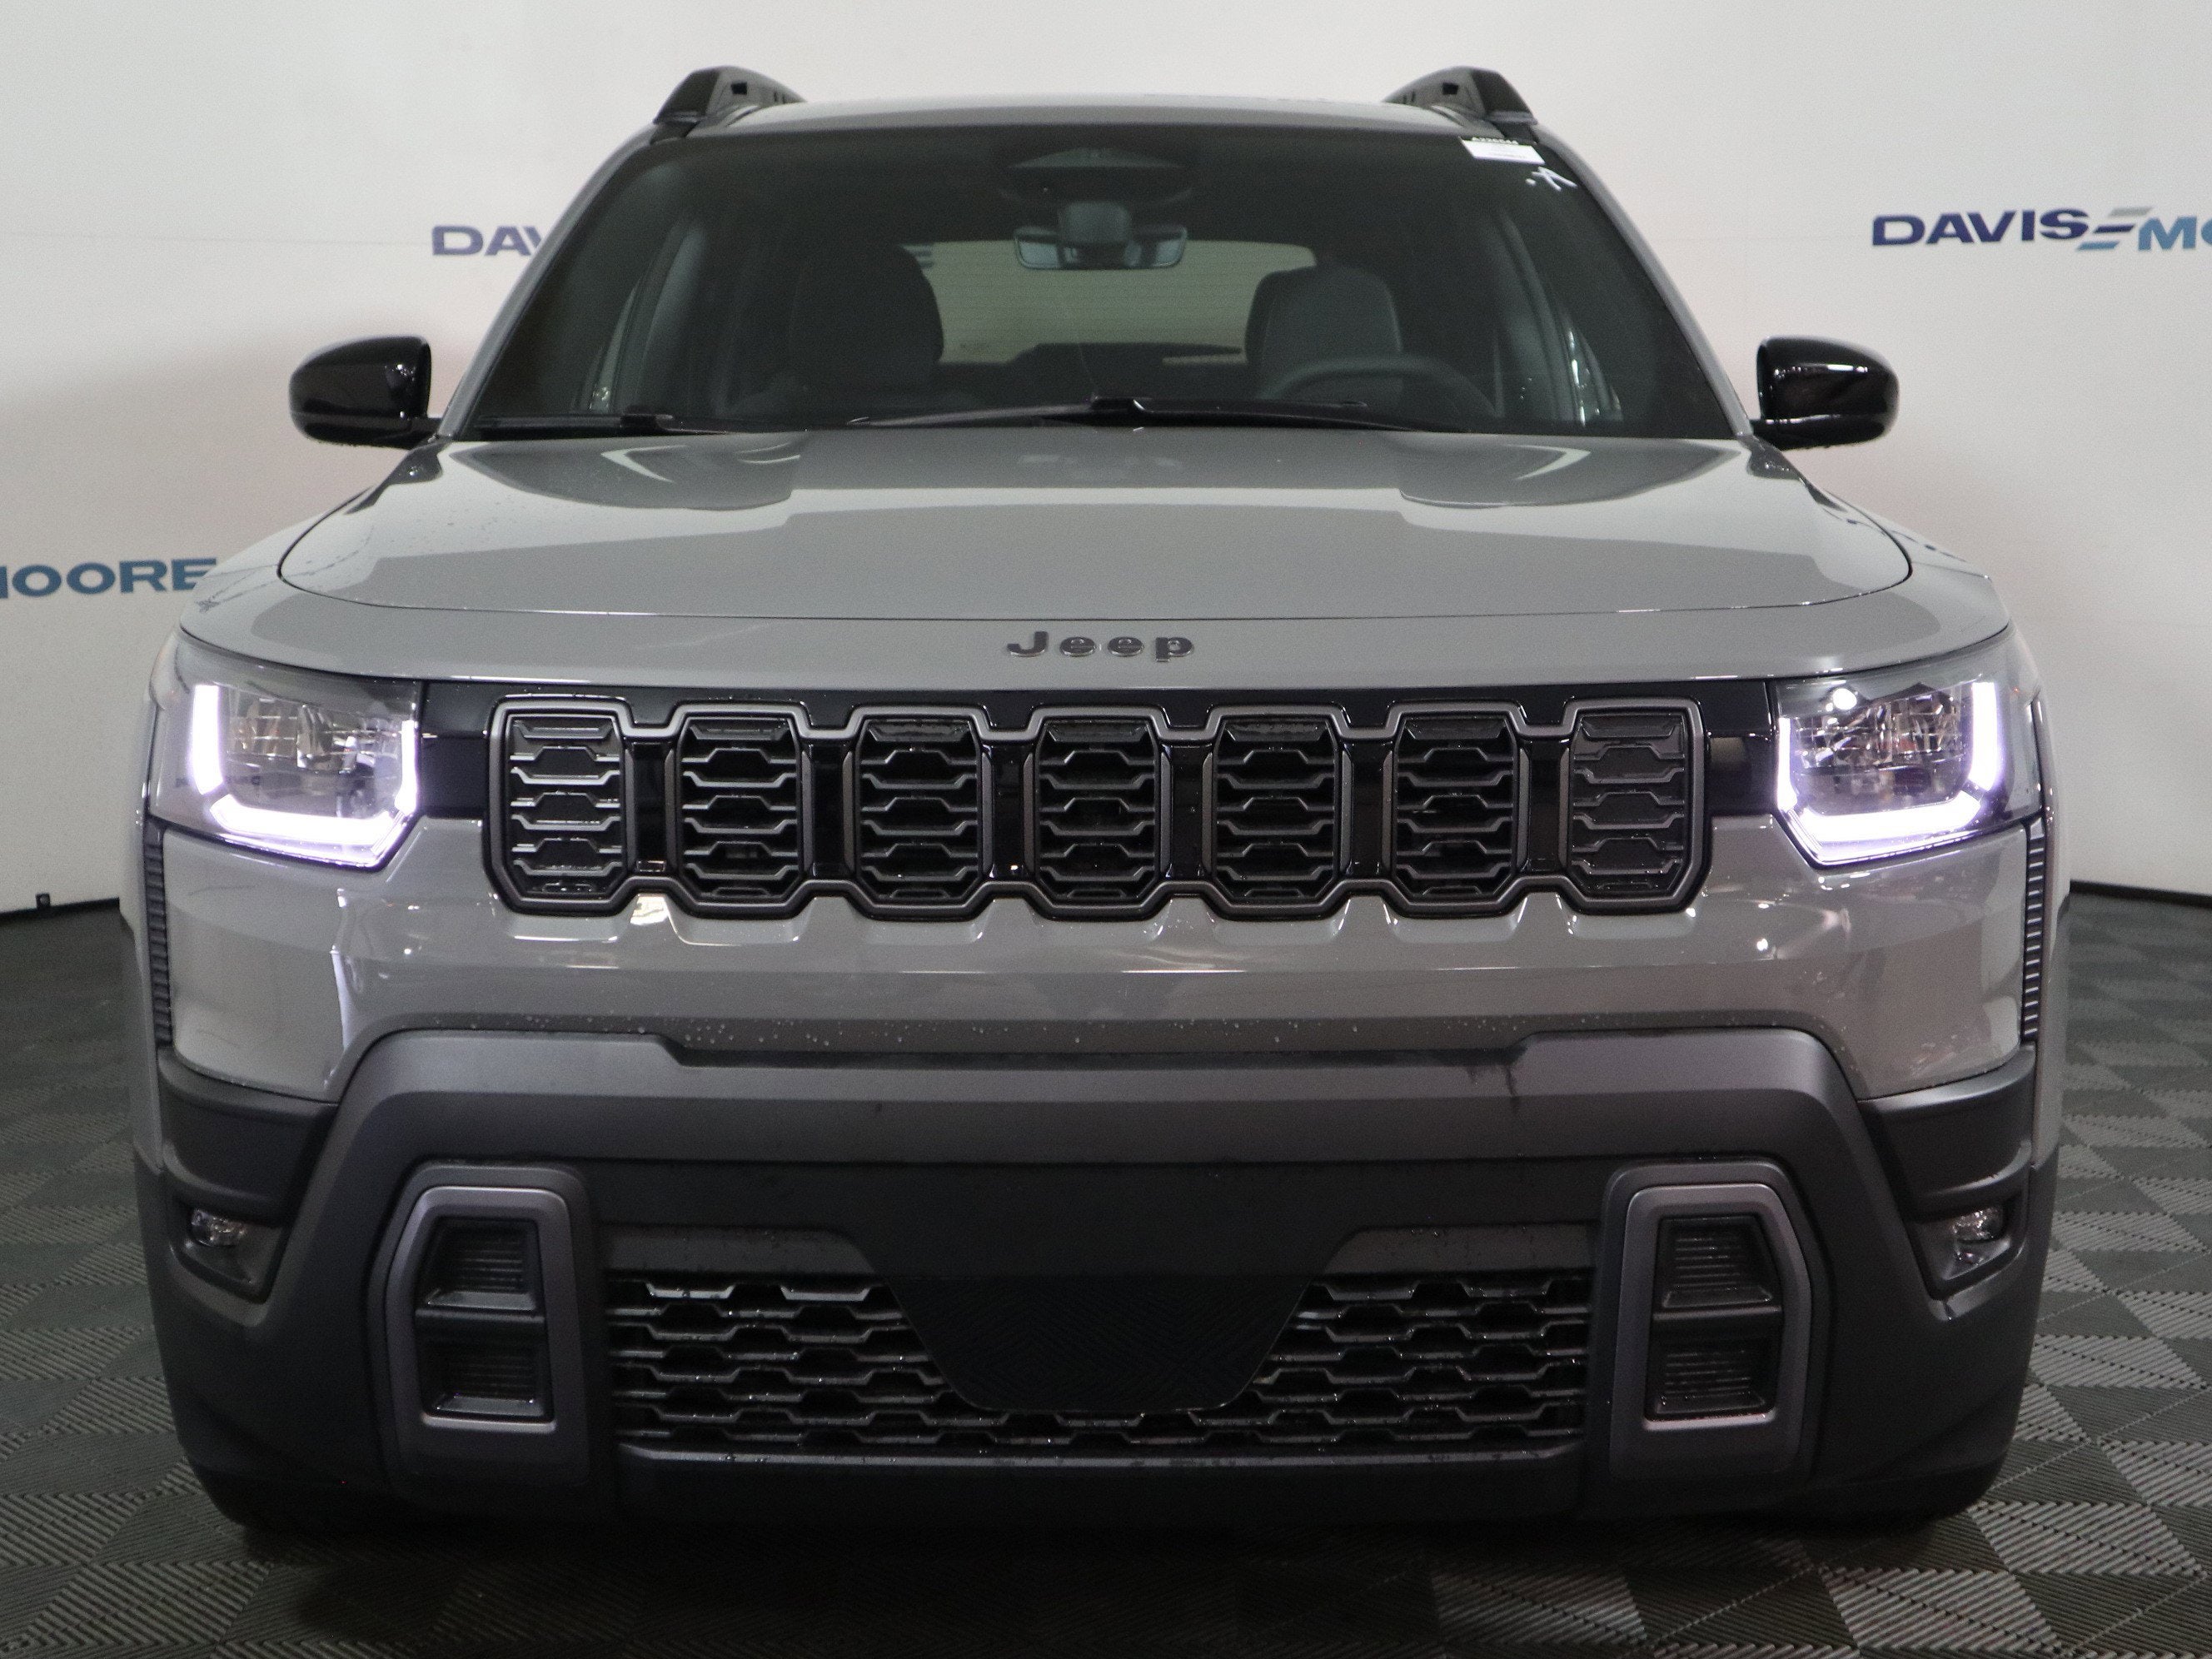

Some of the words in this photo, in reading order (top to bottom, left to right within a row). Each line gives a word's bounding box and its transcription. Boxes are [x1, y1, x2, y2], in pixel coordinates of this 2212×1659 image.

[1872, 207, 2090, 246] DAVIS
[2137, 213, 2212, 251] M
[0, 557, 217, 599] OORE
[1006, 630, 1194, 662] Jeep
